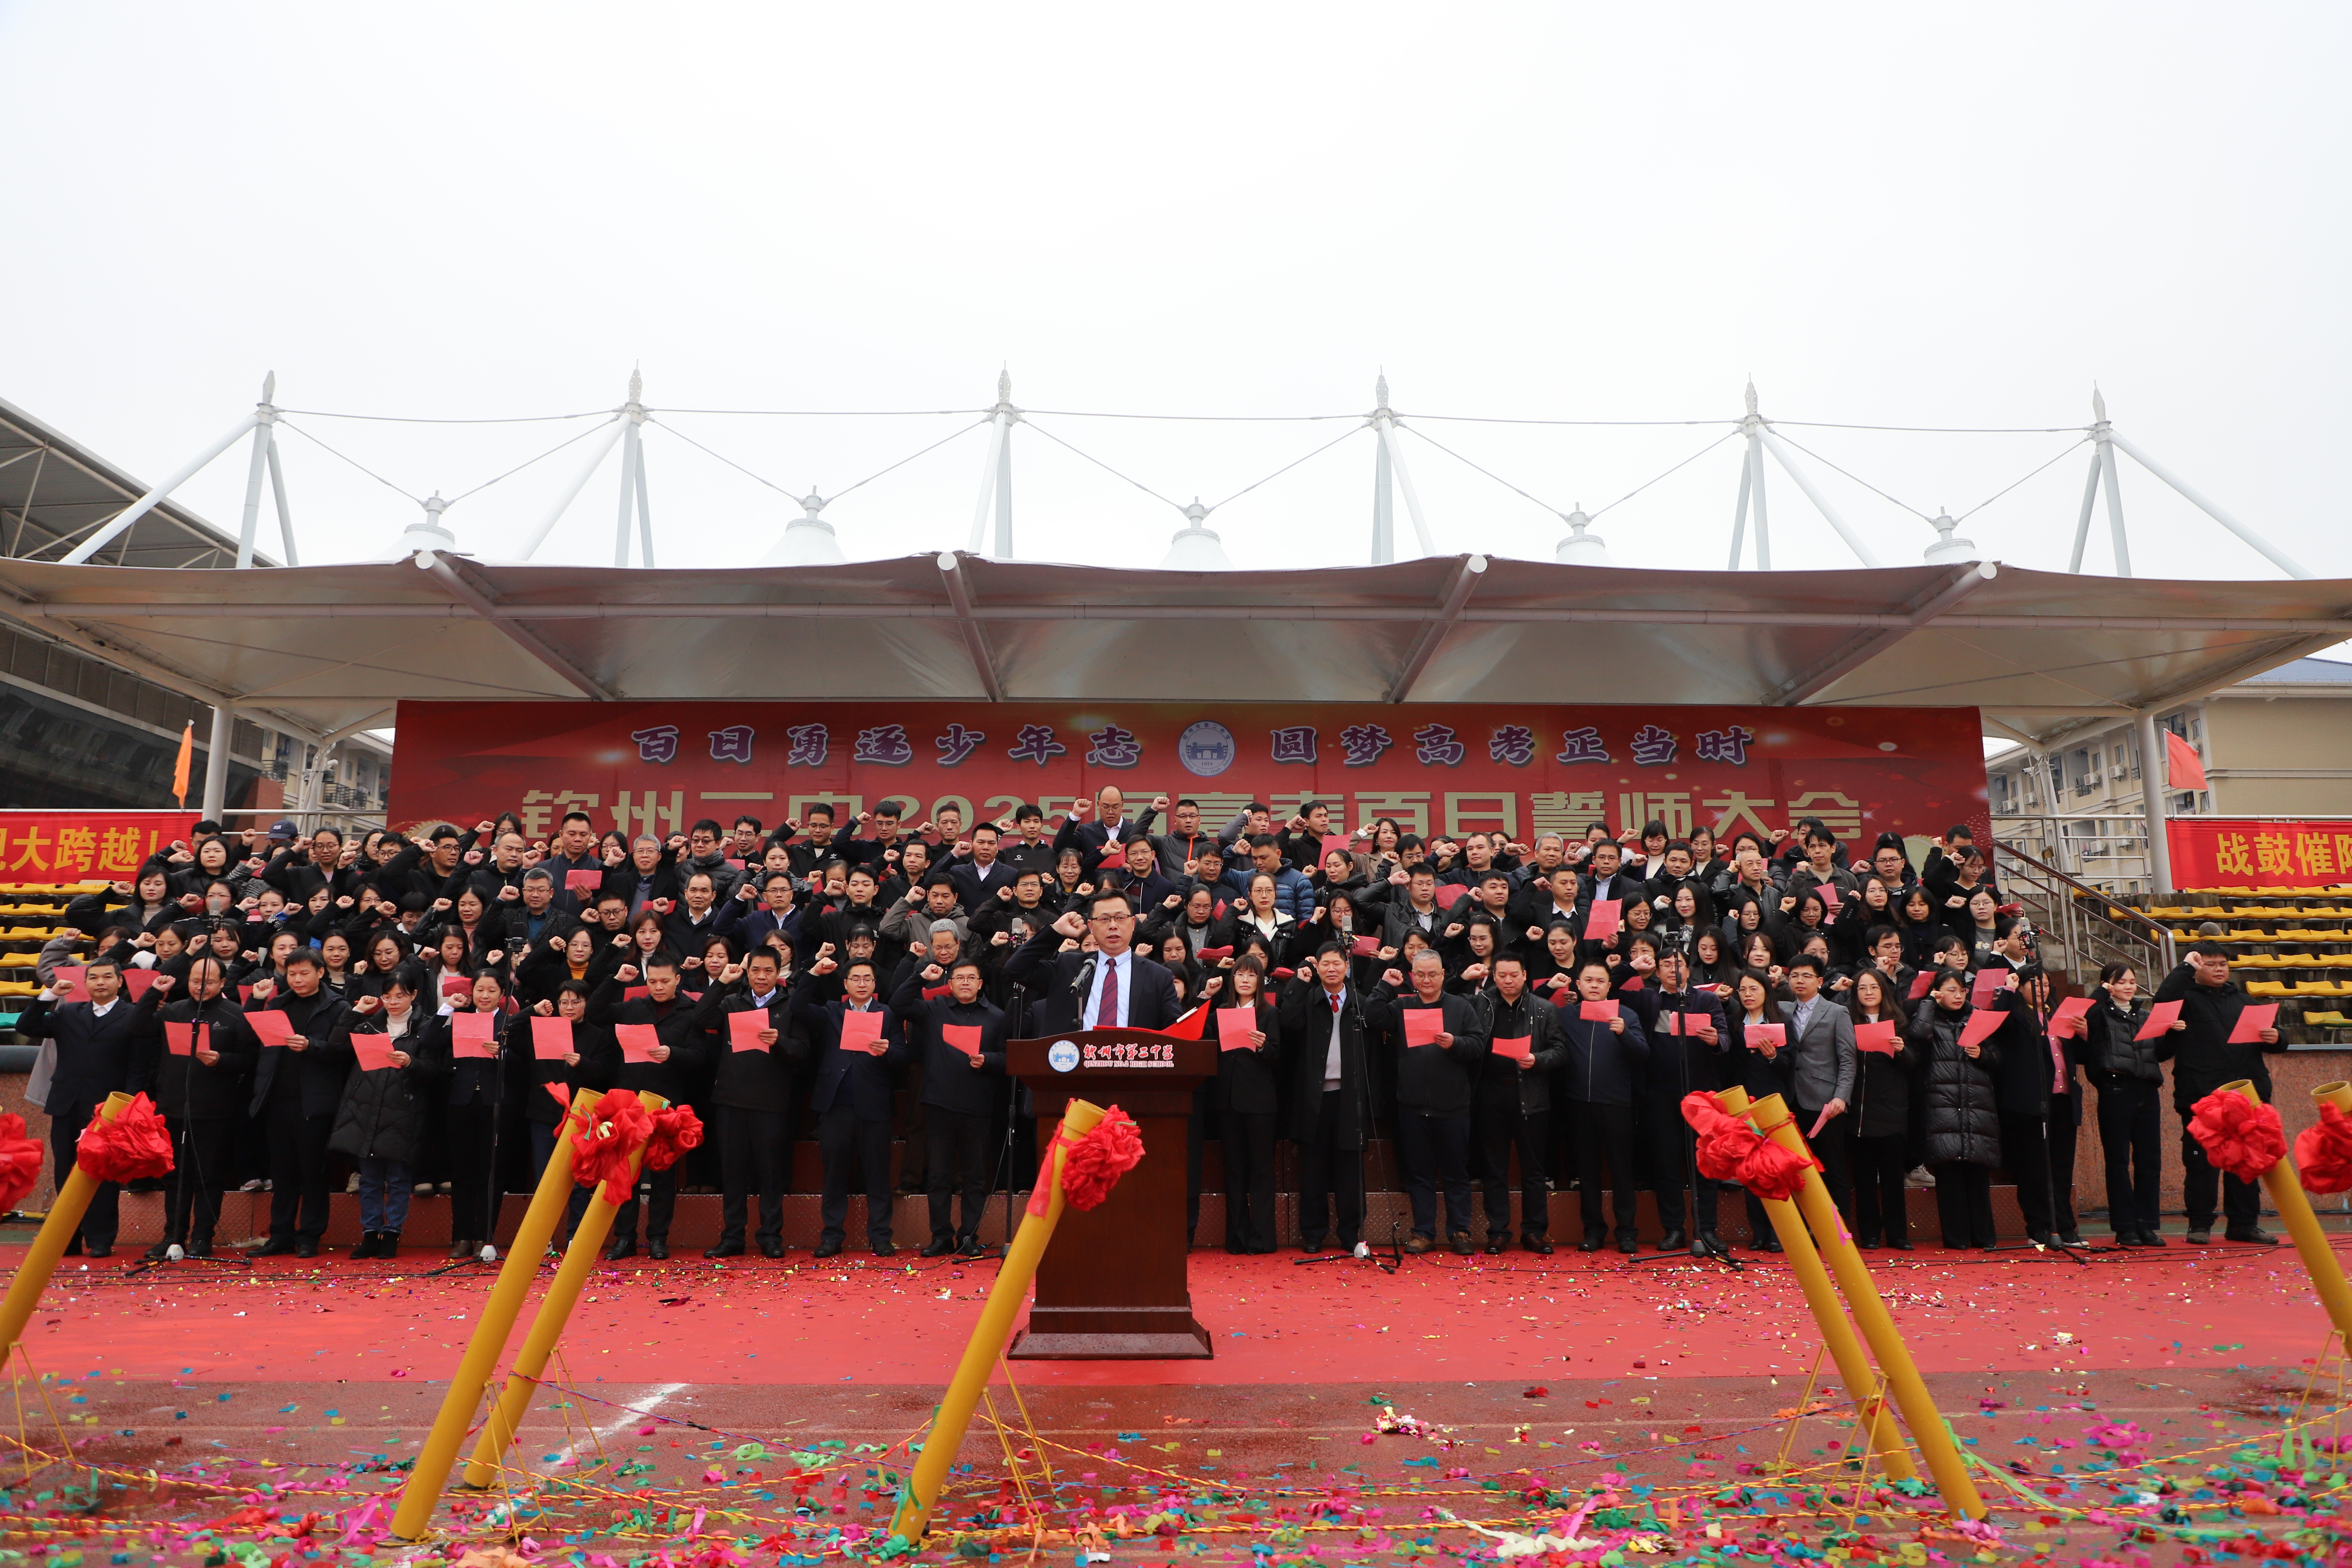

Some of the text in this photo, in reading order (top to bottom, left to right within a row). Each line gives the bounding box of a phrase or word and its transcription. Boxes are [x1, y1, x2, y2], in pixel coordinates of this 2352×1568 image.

[631, 723, 1141, 766] 百日勇逐少年志
[1270, 723, 1752, 765] 圆梦高考正当时
[0, 826, 159, 872] 大跨越！
[1083, 1043, 1174, 1060] 钦州市第二中学
